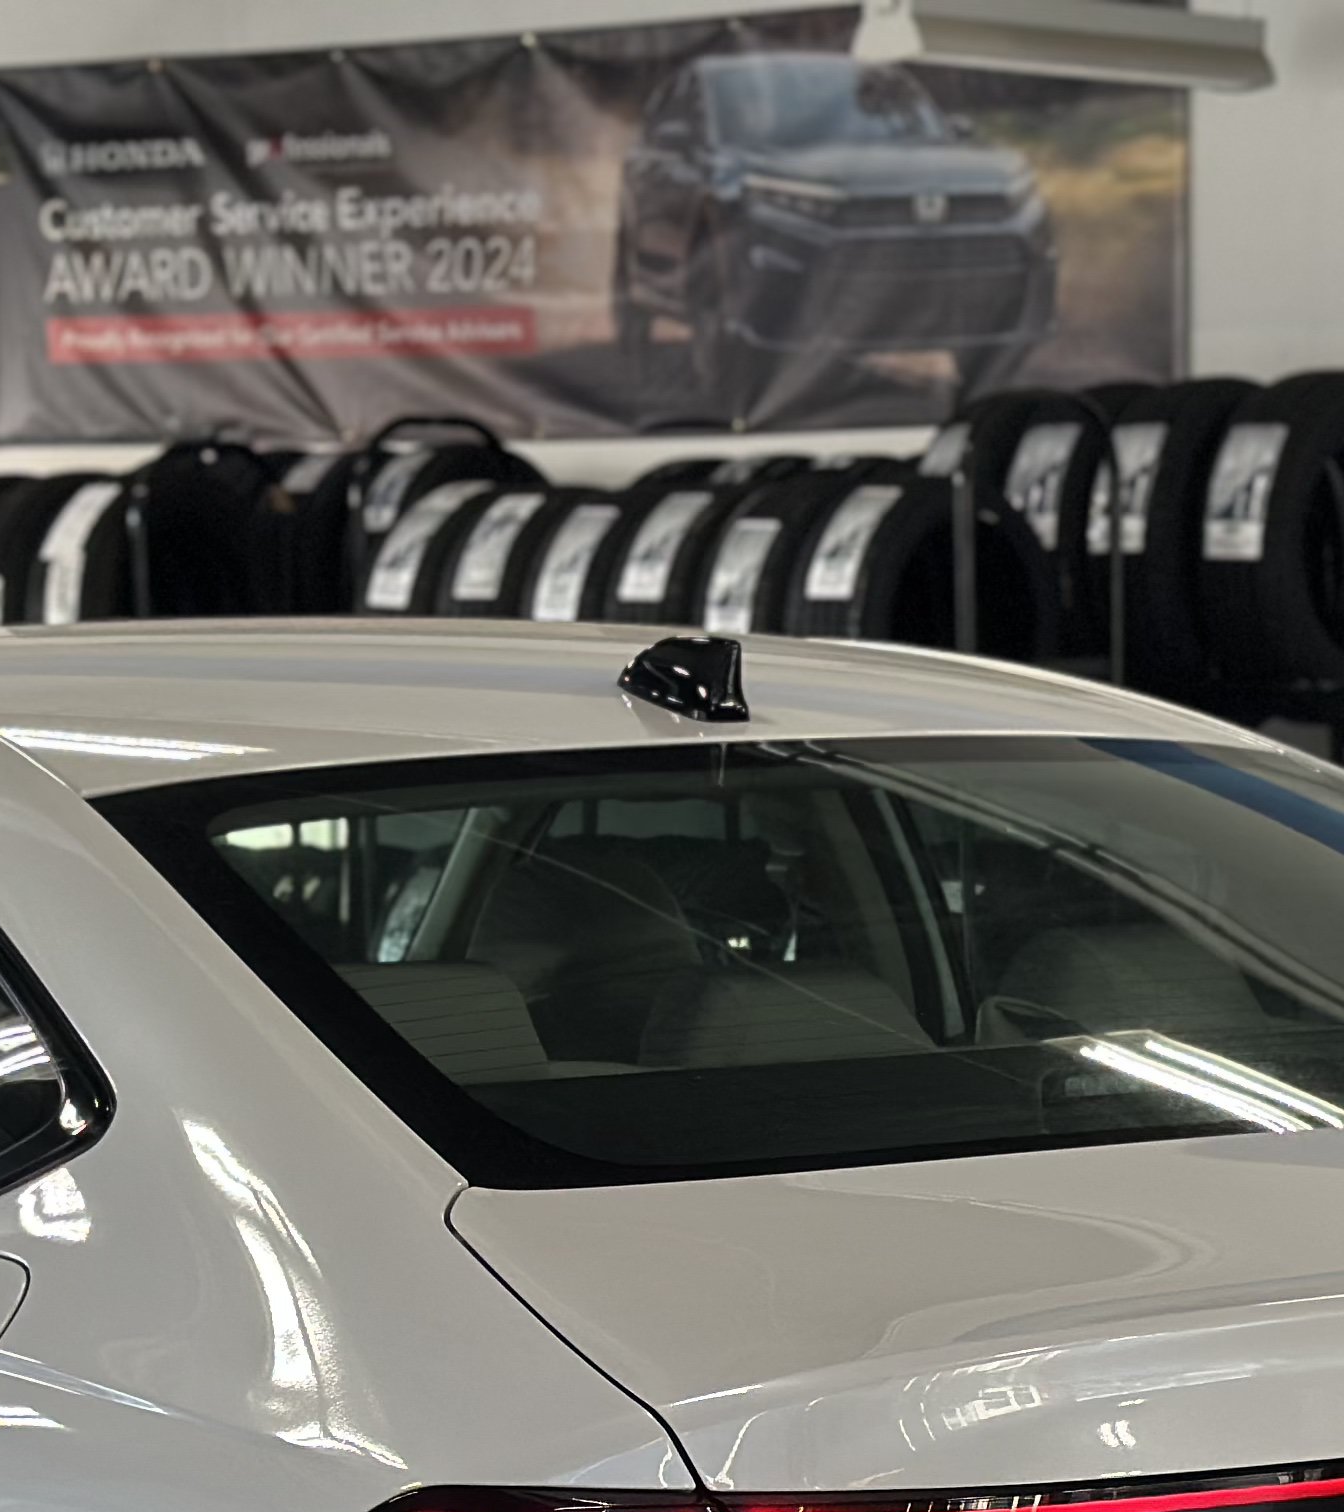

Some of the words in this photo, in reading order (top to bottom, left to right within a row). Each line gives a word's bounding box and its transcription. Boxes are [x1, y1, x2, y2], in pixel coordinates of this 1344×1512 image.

[68, 137, 206, 173] HONDA
[38, 198, 203, 243] Customer
[210, 190, 330, 236] Service
[336, 183, 541, 239] Experience
[42, 246, 213, 304] AWARD
[224, 240, 416, 298] WINNER
[425, 236, 536, 291] 2024
